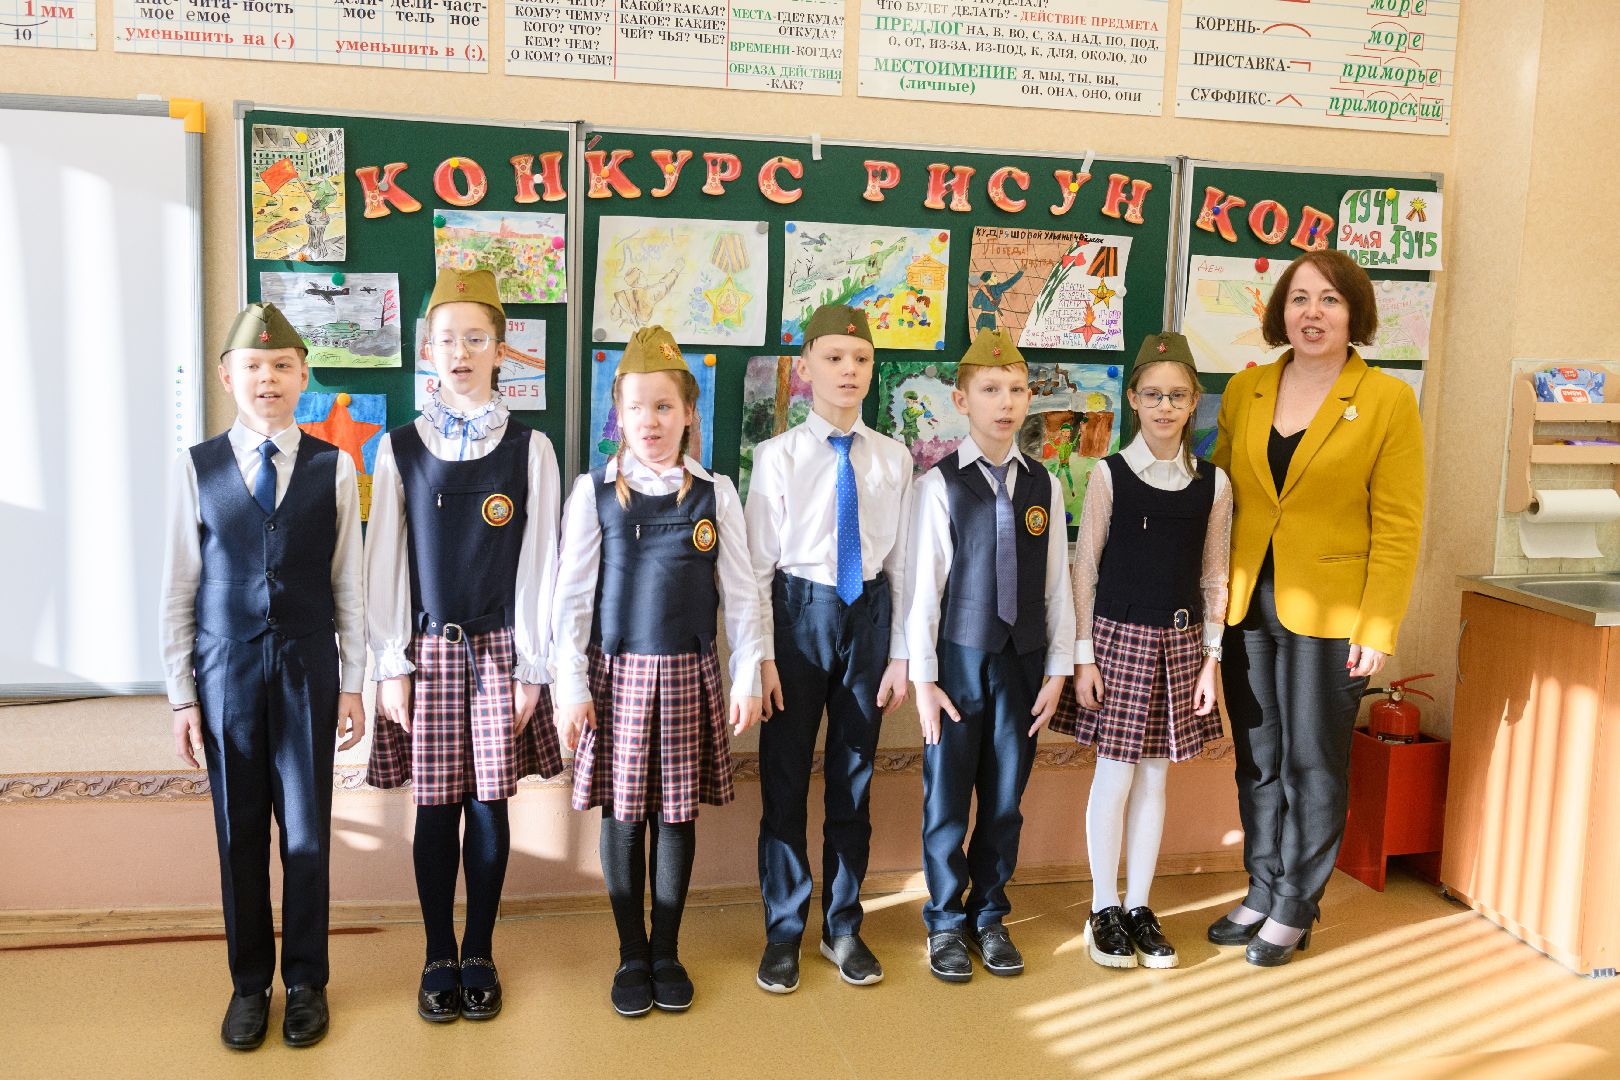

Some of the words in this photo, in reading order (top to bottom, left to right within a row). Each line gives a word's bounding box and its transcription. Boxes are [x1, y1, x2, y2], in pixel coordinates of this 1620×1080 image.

[24, 0, 35, 16] 1
[41, 6, 74, 19] мм
[243, 1, 294, 13] ность
[443, 1, 487, 12] част-
[515, 5, 560, 19] КОМУ?
[565, 9, 610, 22] ЧЕМУ?
[620, 0, 671, 12] КАКОЙ?
[674, 3, 726, 16] КАКАЯ?
[1370, 0, 1424, 16] море
[140, 8, 174, 20] мое
[186, 10, 231, 24] емое
[343, 8, 376, 19] мое
[396, 11, 435, 23] тель
[450, 14, 480, 26] ное
[620, 14, 670, 27] КАКОЕ?
[675, 17, 726, 31] КАКИЕ?
[807, 14, 844, 26] КУДА?
[877, 0, 902, 10] ЧТО
[906, 2, 949, 15] БУДЕТ
[952, 5, 1010, 19] ДЕЛАТЬ?
[1021, 10, 1088, 26] ДЕЙСТВИЕ
[1091, 17, 1159, 31] ПРЕДМЕТА
[524, 21, 564, 34] КОГО?
[568, 24, 602, 36] ЧТО?
[778, 25, 837, 39] ОТКУДА?
[875, 16, 964, 36] ПРЕДЛОГ
[966, 25, 989, 37] НА,
[993, 27, 1004, 38] В,
[1009, 28, 1028, 40] ВО,
[1032, 30, 1043, 41] С,
[1047, 31, 1067, 43] ЗА,
[1072, 33, 1102, 45] НАД,
[1105, 36, 1126, 47] ПО,
[1130, 37, 1159, 51] ПОД,
[1195, 16, 1261, 34] КОРЕНЬ-
[14, 28, 32, 40] 10
[125, 27, 234, 45] уменьшить
[243, 33, 265, 46] на
[273, 32, 296, 49] (-)
[525, 35, 560, 48] КЕМ?
[565, 38, 600, 50] ЧЕМ?
[620, 26, 654, 40] ЧЕЙ?
[658, 30, 690, 42] ЧЬЯ?
[694, 33, 726, 45] ЧЬЕ?
[1368, 30, 1422, 52] море
[335, 40, 439, 57] уменьшить
[445, 46, 455, 57] в
[888, 36, 900, 46] О,
[905, 37, 925, 49] ОТ,
[930, 38, 971, 52] ИЗ-ЗА,
[975, 41, 1027, 57] ИЗ-ПОД,
[1031, 46, 1043, 57] К,
[1046, 48, 1077, 61] ДЛЯ,
[1081, 50, 1127, 63] ОКОЛО,
[1130, 54, 1147, 64] ДО
[511, 49, 520, 60] О
[525, 50, 560, 62] КОМ?
[564, 52, 574, 63] О
[578, 53, 612, 66] ЧЕМ?
[1193, 52, 1291, 72] ПРИСТАВКА-
[729, 63, 776, 76] ОБРАЗА
[780, 65, 842, 80] ДЕЙСТВИЯ
[874, 57, 1018, 80] МЕСТОИМЕНИЕ
[1023, 69, 1034, 80] Я,
[1040, 71, 1064, 83] МЫ,
[1069, 72, 1092, 84] ТЫ,
[1096, 74, 1119, 87] ВЫ,
[1342, 61, 1438, 85] приморье
[765, 79, 804, 91] -КАК?
[900, 76, 976, 95] (личные)
[1021, 85, 1043, 96] ОН,
[1047, 86, 1078, 98] ОНА,
[1082, 88, 1111, 101] ОНО,
[1190, 87, 1271, 105] СУФФИКС-
[1329, 95, 1442, 120] приморский
[1345, 189, 1400, 226] 1941
[1339, 224, 1352, 242] 9
[1390, 225, 1438, 259] 1945
[1340, 250, 1398, 266] ОБЕДА
